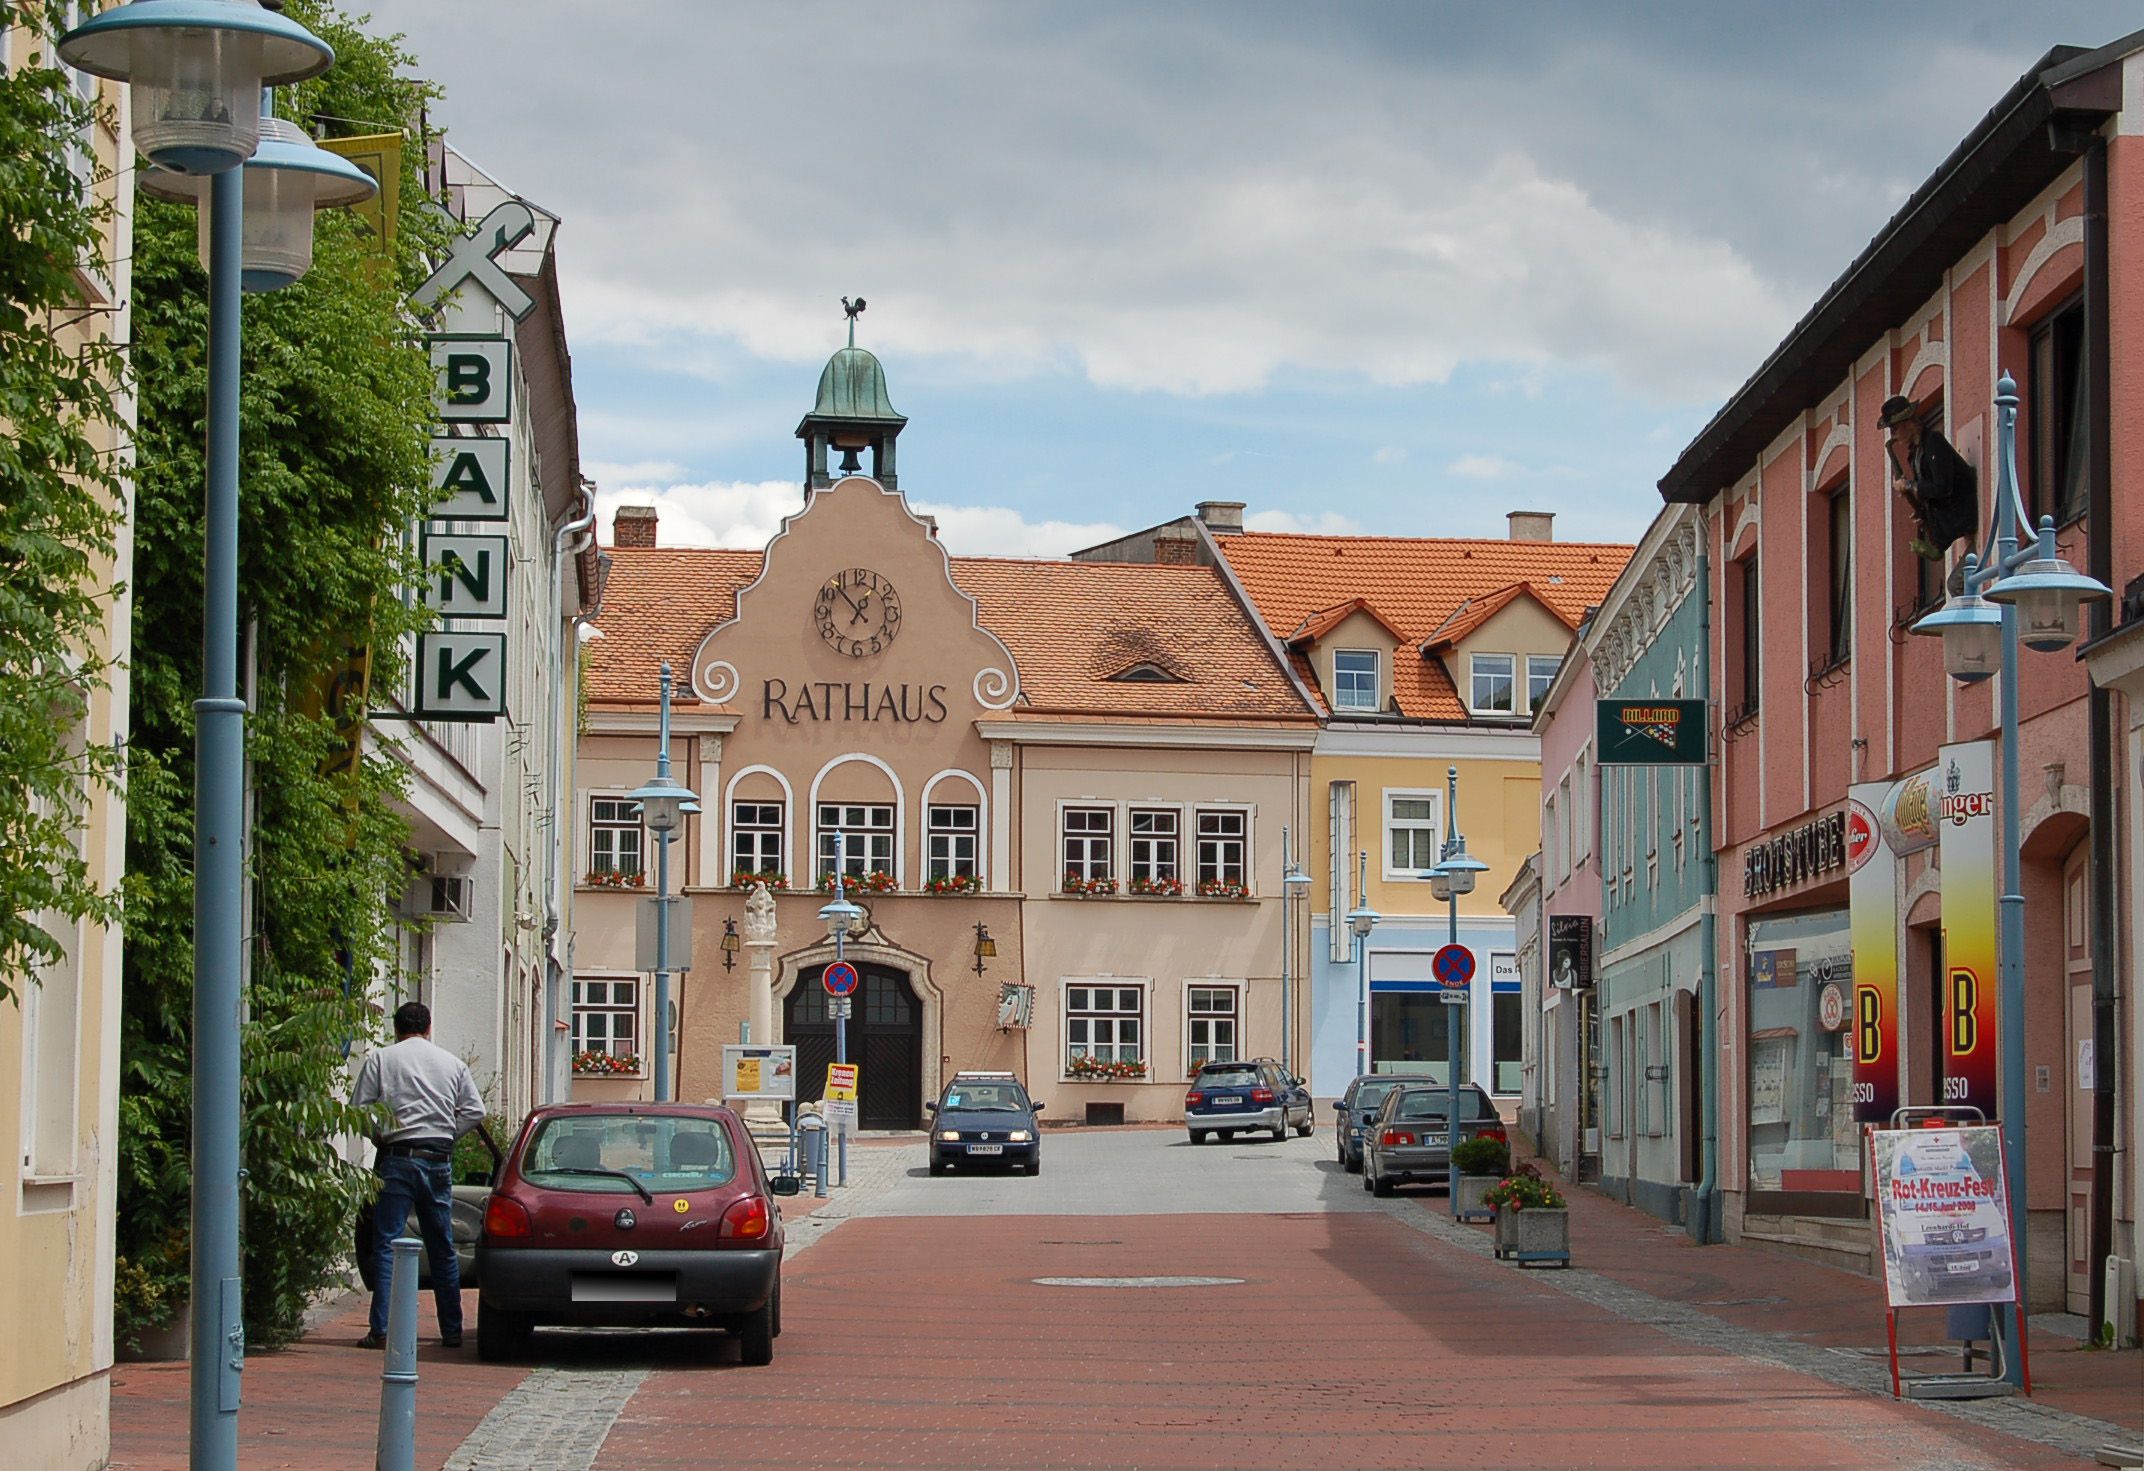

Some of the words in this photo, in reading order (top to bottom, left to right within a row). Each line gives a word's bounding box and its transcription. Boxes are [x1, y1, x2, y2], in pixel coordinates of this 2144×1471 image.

[436, 353, 498, 701] BANK
[853, 568, 867, 588] 12
[820, 585, 836, 602] 10
[881, 583, 893, 600] 2
[816, 604, 829, 620] 9
[884, 605, 899, 623] 3
[821, 621, 835, 640] 8
[835, 634, 846, 654] 7
[851, 640, 863, 657] 6
[870, 635, 882, 654] 5
[763, 678, 948, 725] RATHAUS
[1622, 707, 1680, 723] BILLARD
[1743, 811, 1845, 898] BROTSTUBE
[1551, 918, 1579, 937] Silvia
[1580, 917, 1590, 987] FRISIERSALON
[1495, 965, 1513, 974] Das
[1444, 979, 1464, 988] ENDE
[1891, 1176, 1996, 1200] Rot-Kreuz-Fest
[618, 1252, 632, 1264] A
